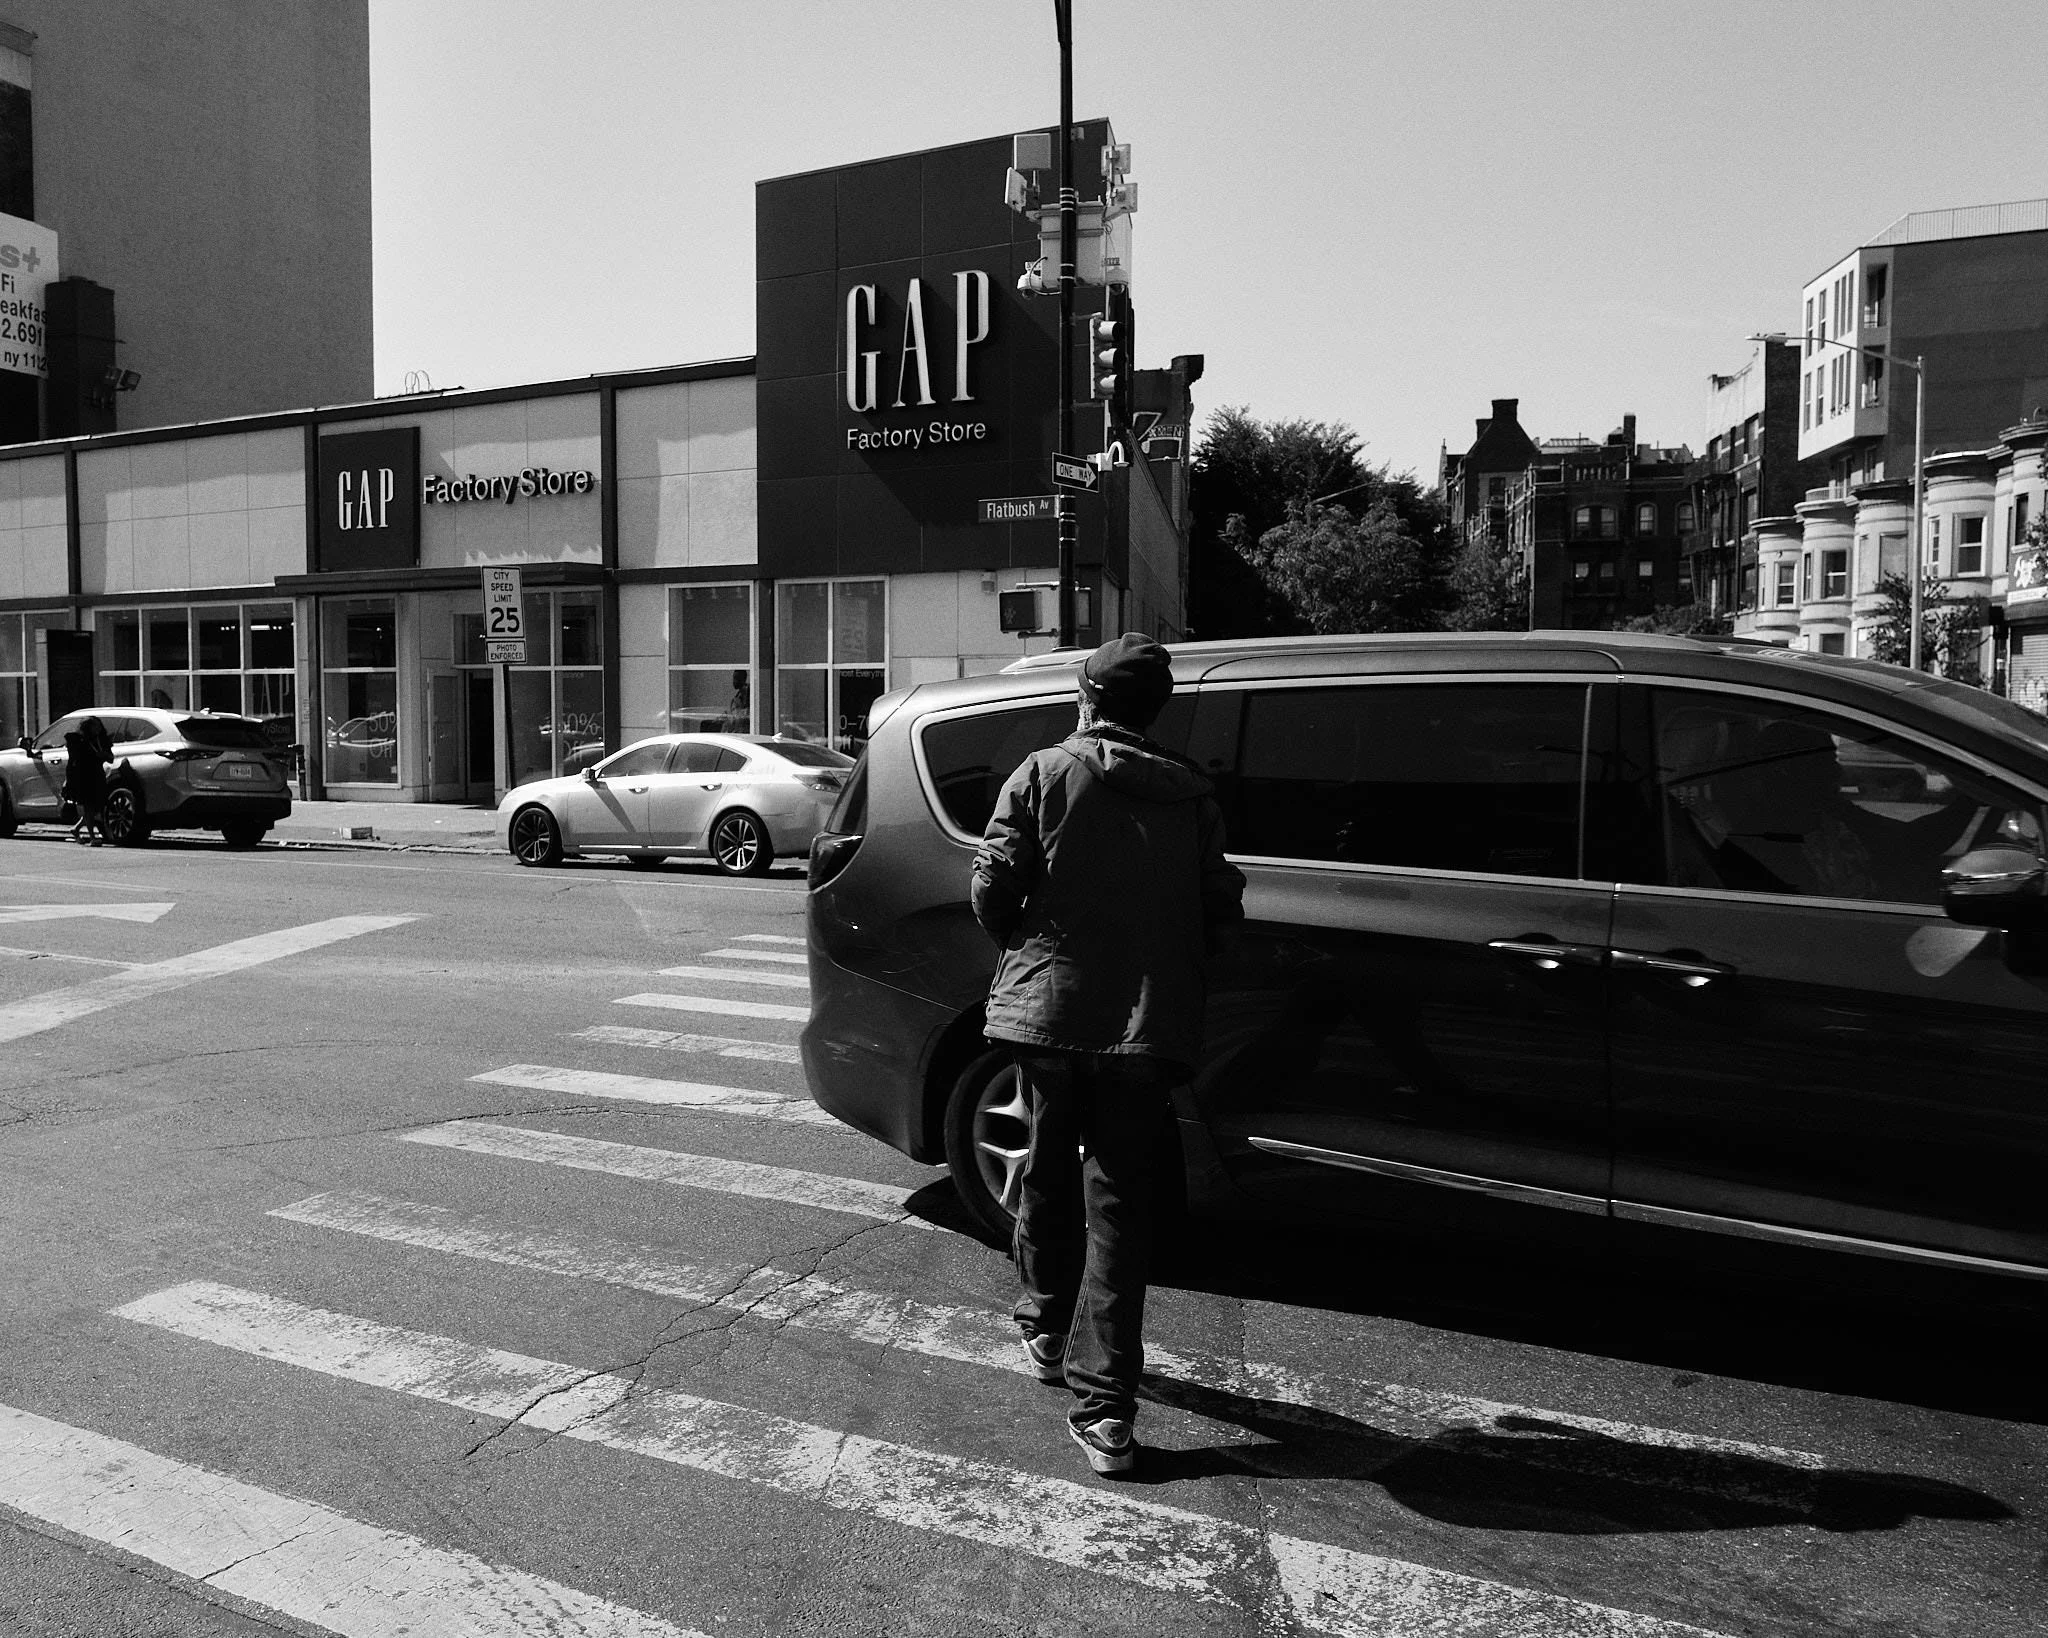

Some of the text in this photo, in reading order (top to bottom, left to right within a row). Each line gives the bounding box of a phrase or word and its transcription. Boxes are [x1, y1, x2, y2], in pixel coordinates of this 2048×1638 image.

[2, 273, 15, 294] Fi
[846, 269, 990, 413] GAP
[4, 351, 20, 368] ny
[847, 420, 987, 450] Factory Store
[1060, 464, 1093, 481] ONE WAY
[422, 467, 590, 505] Factory Store
[338, 467, 394, 531] GAP
[986, 499, 1049, 519] Flatbush Av
[493, 571, 510, 580] CITY
[490, 582, 514, 592] SPEED
[493, 594, 513, 603] LIMIT
[490, 606, 520, 633] 25
[490, 652, 524, 661] ENFORCED
[496, 644, 518, 652] PHOTO
